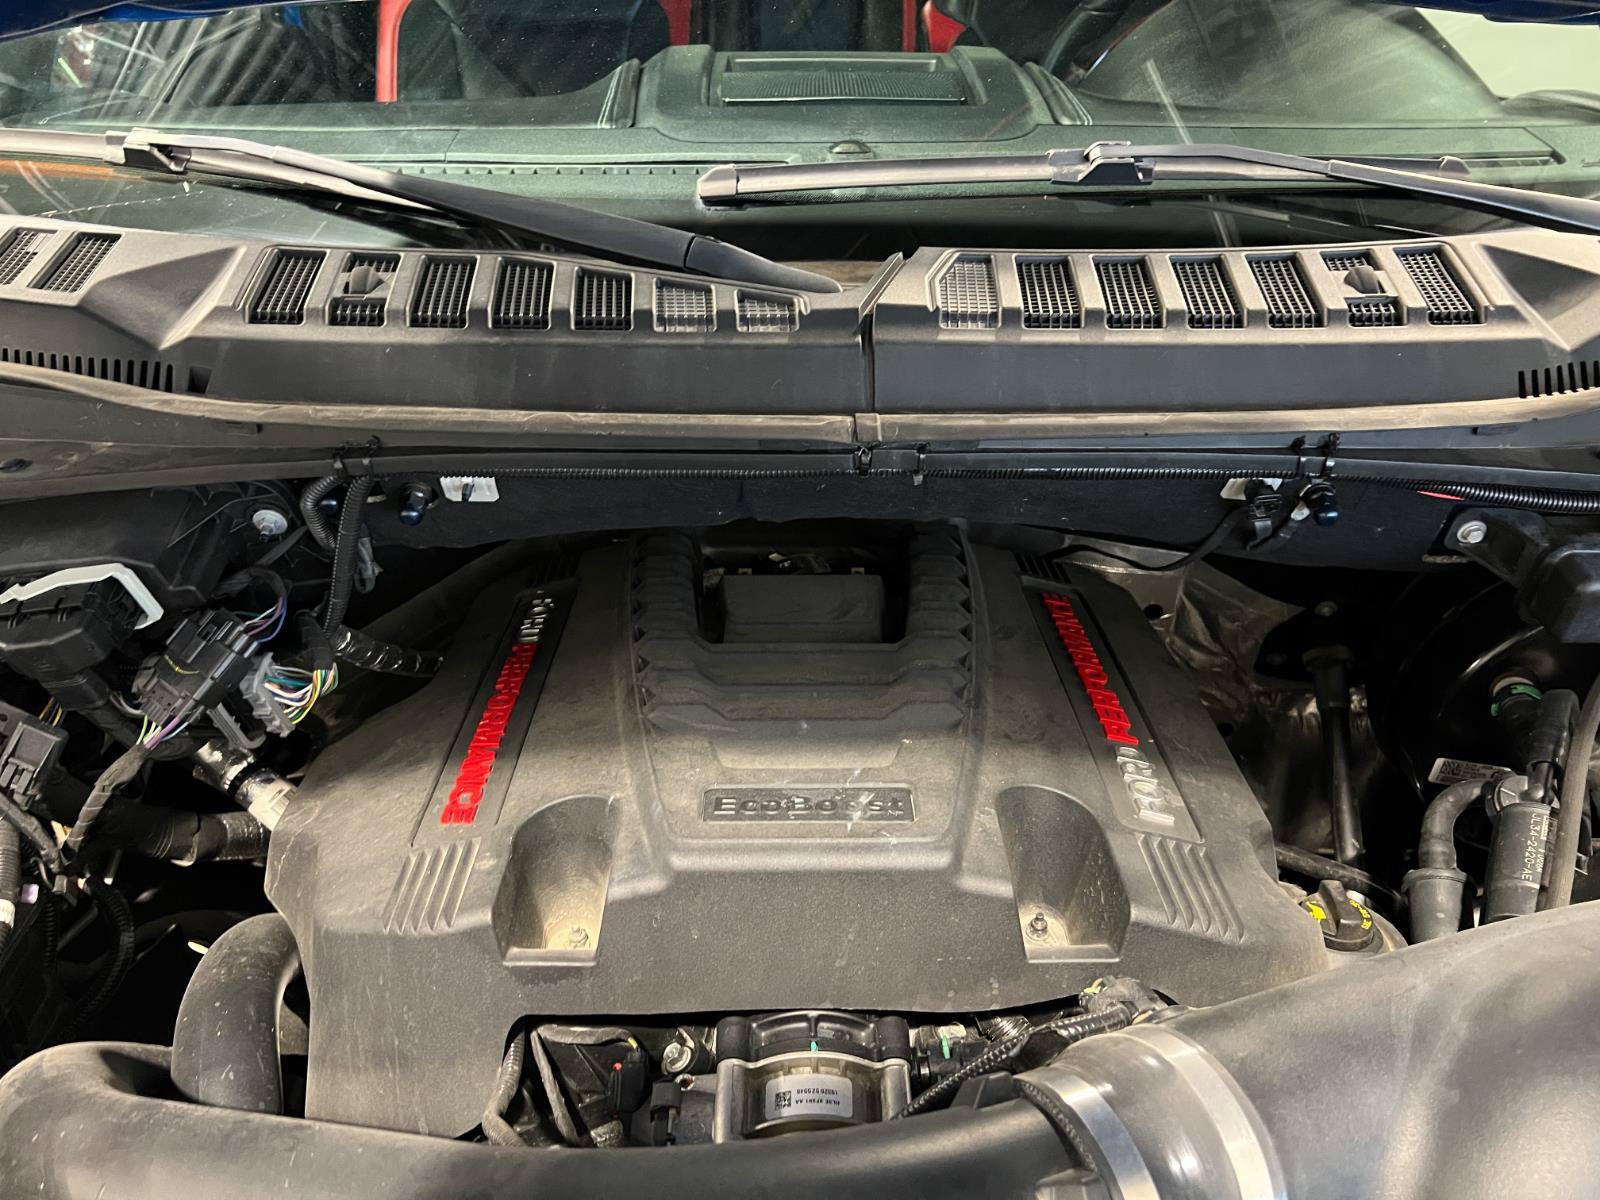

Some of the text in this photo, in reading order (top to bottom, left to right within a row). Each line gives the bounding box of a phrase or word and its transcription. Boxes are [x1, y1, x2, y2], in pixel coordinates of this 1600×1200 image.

[440, 642, 538, 826] PERFORMANCE
[1042, 590, 1176, 828] FORD PERFORMANCE
[1521, 812, 1542, 882] JL34-2420-AE
